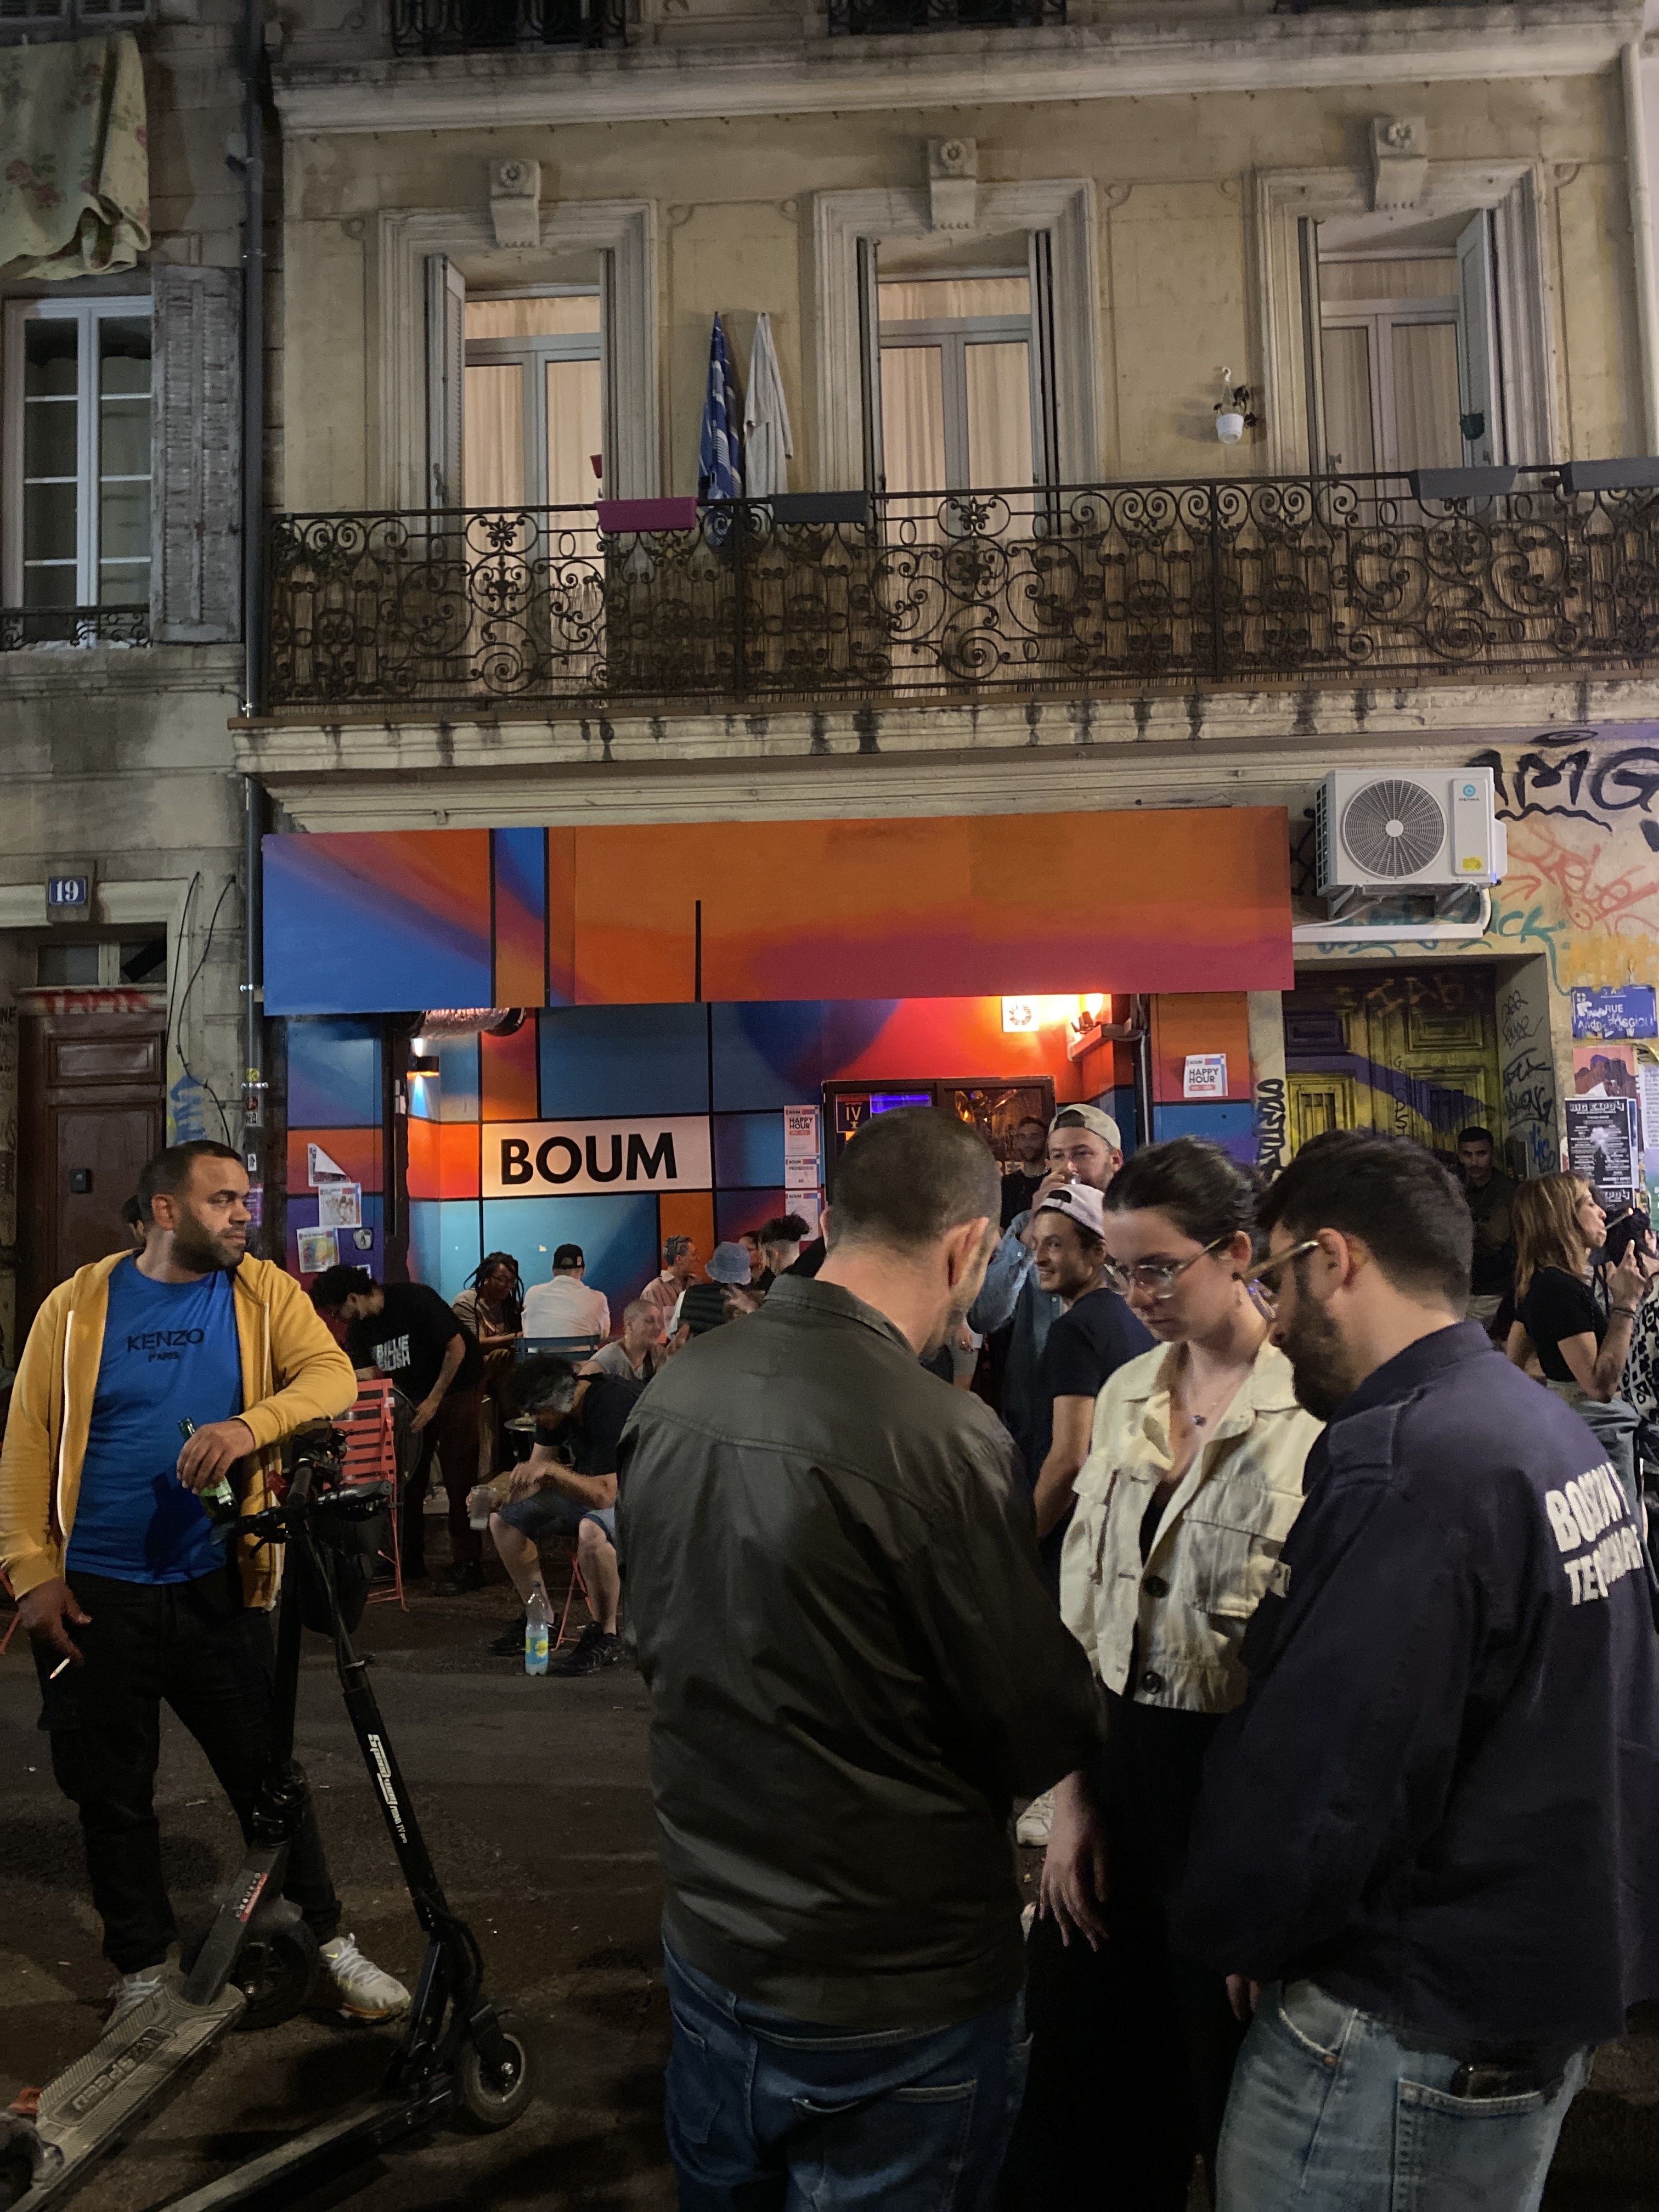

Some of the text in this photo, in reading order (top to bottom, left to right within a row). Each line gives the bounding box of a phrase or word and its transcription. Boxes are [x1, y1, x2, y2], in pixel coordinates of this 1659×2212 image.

[56, 879, 79, 902] 19
[1605, 1005, 1624, 1013] RUE
[845, 1107, 861, 1121] IV
[501, 1132, 678, 1185] BOUM
[127, 1328, 205, 1352] KENZO
